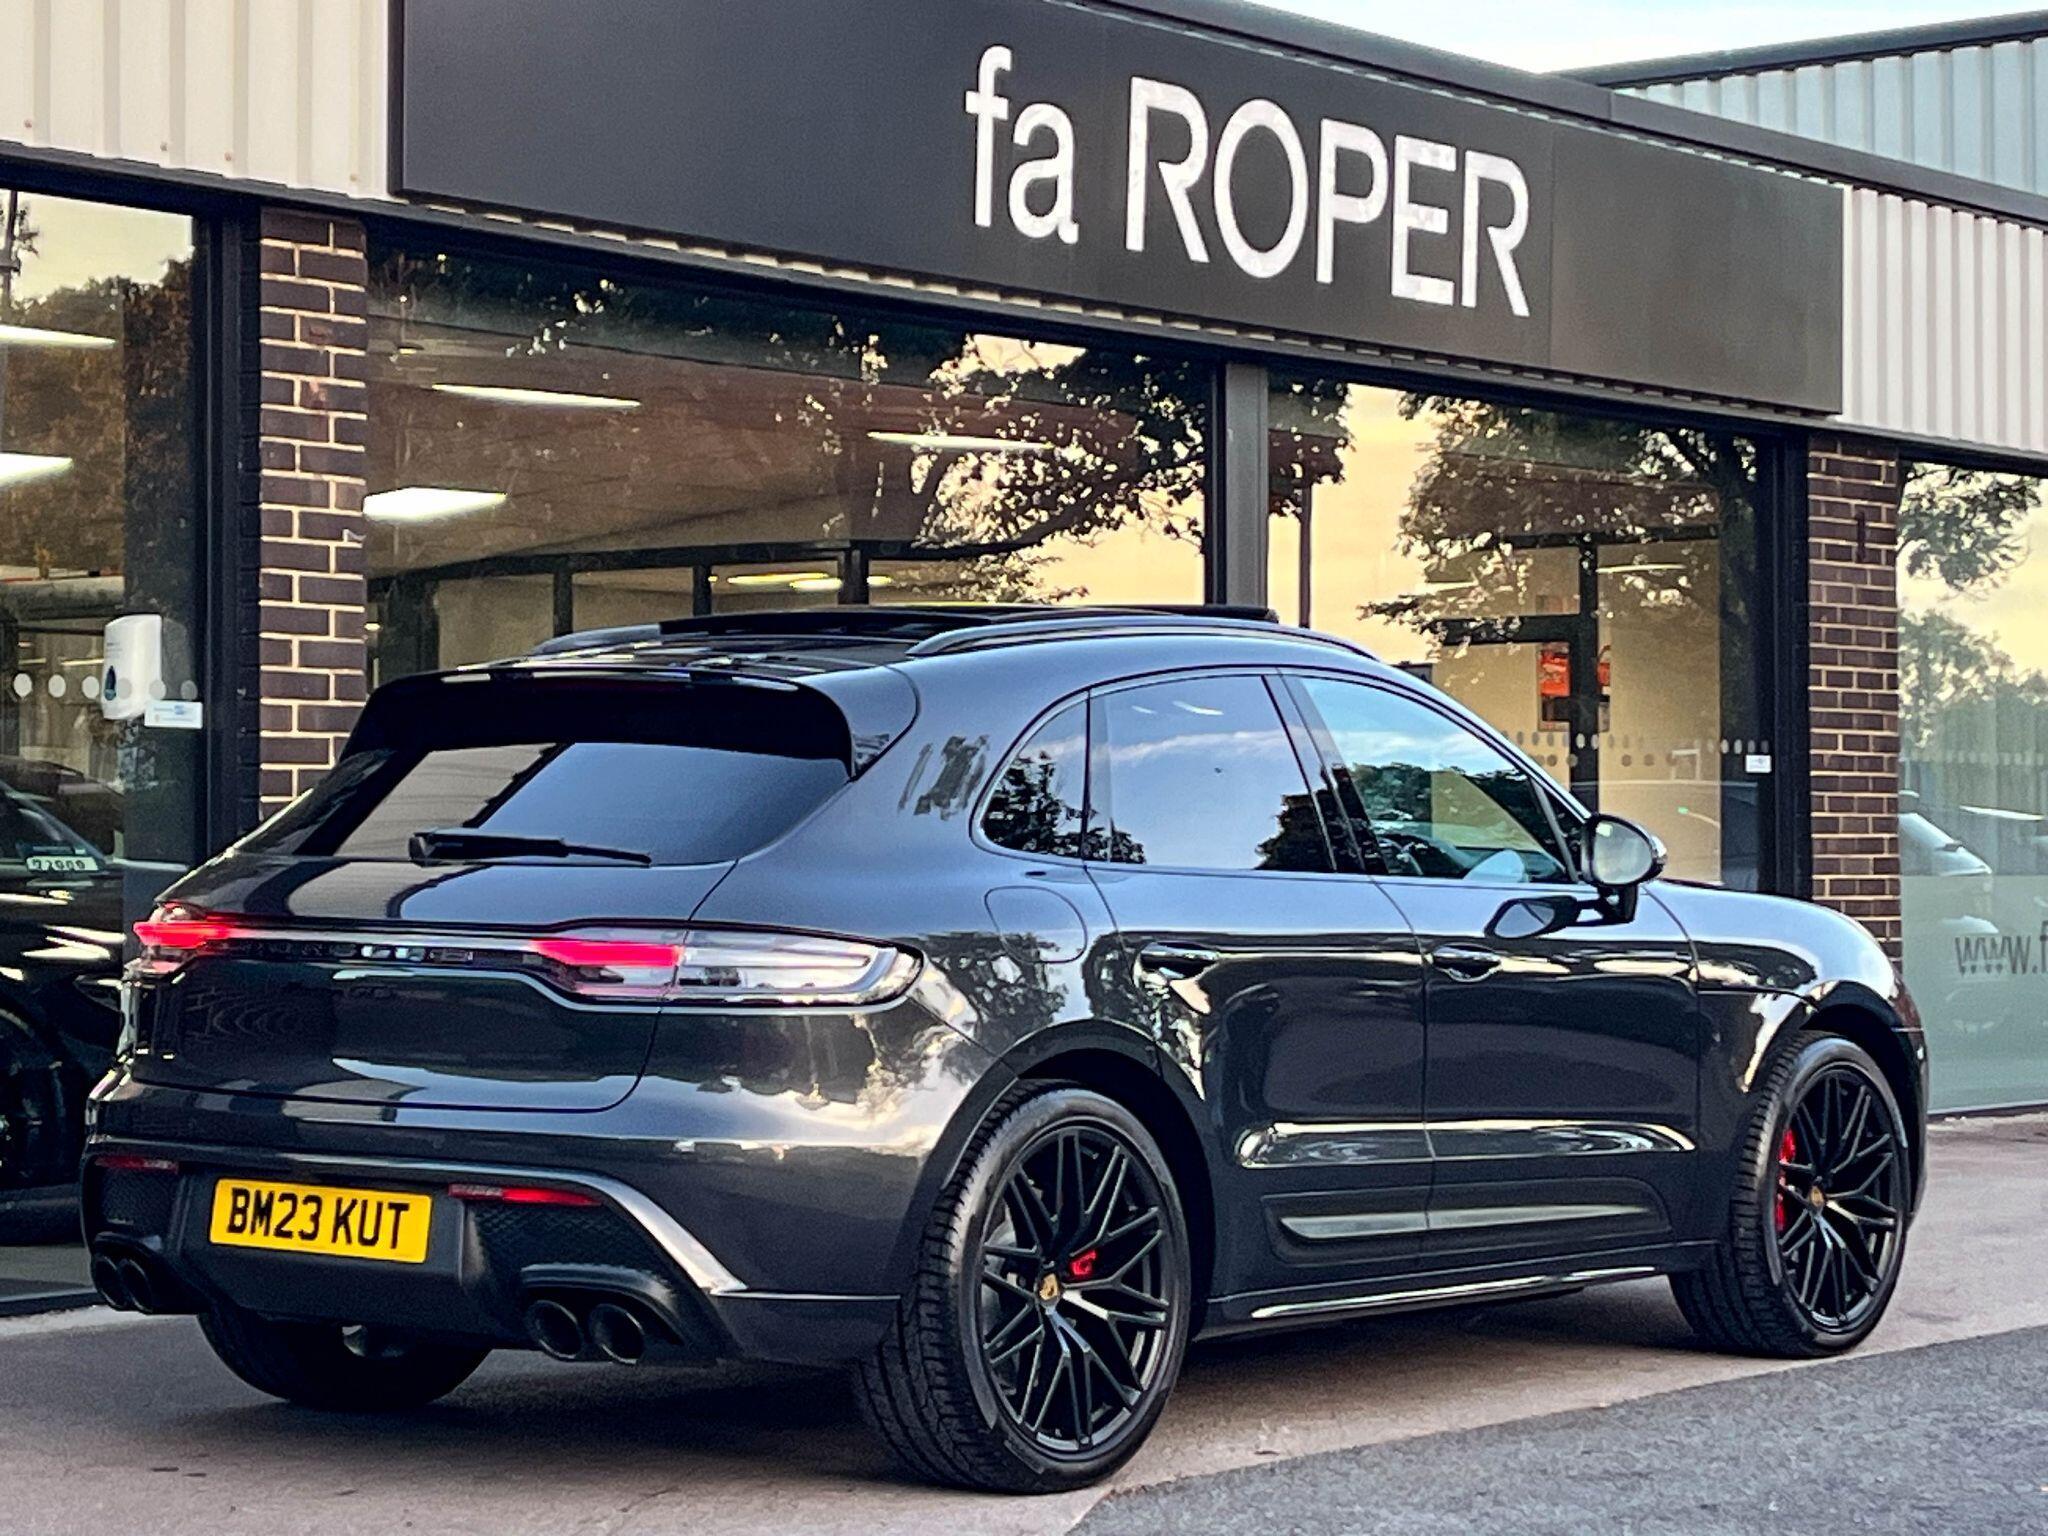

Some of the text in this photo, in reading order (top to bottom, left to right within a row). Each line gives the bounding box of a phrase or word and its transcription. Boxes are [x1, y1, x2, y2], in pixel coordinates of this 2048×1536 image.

[965, 45, 1530, 317] fa ROPER
[227, 1187, 410, 1249] BM23 KUT
